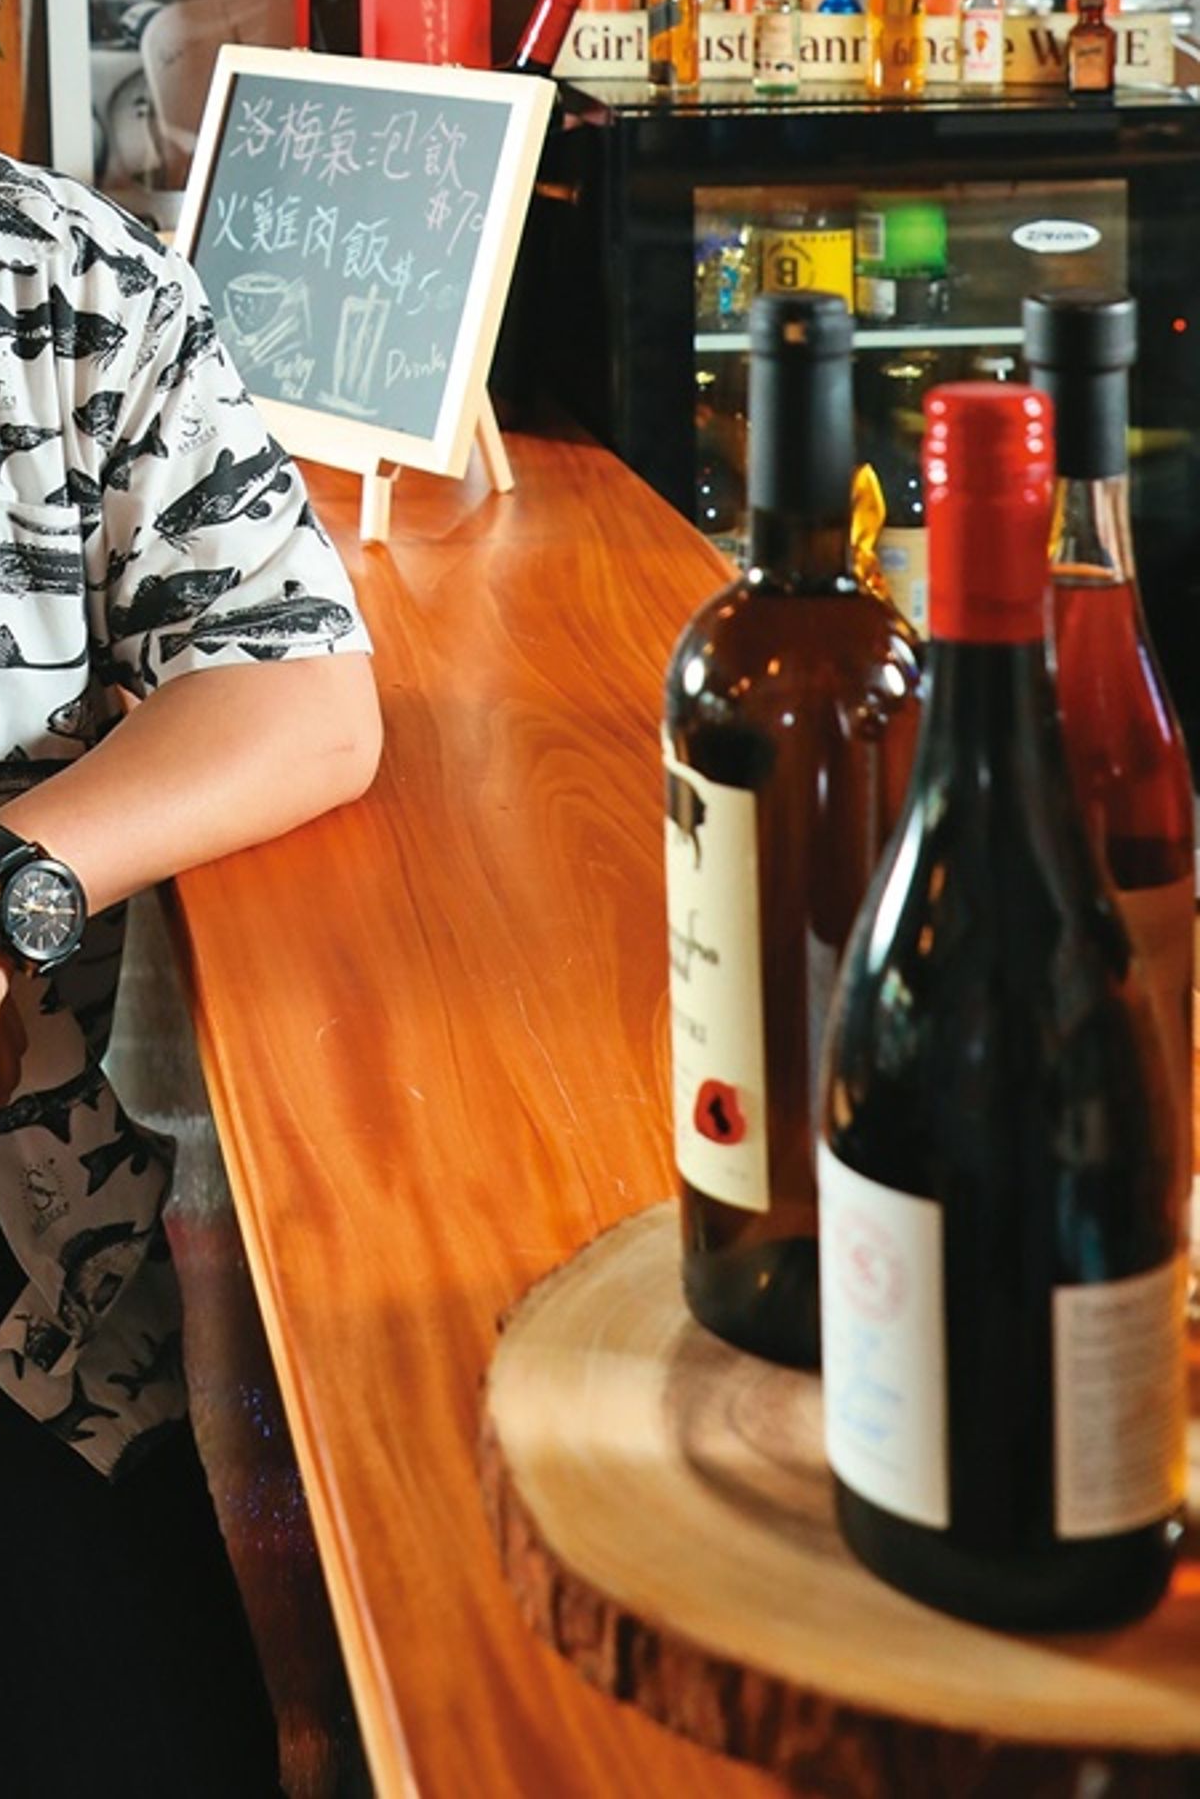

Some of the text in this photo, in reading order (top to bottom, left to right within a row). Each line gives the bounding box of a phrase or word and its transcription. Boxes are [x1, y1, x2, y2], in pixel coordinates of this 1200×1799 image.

[572, 26, 644, 62] Girl
[703, 32, 748, 63] ust
[800, 34, 868, 65] ann
[212, 186, 395, 286] 火雞肉飯
[425, 189, 485, 256] $70
